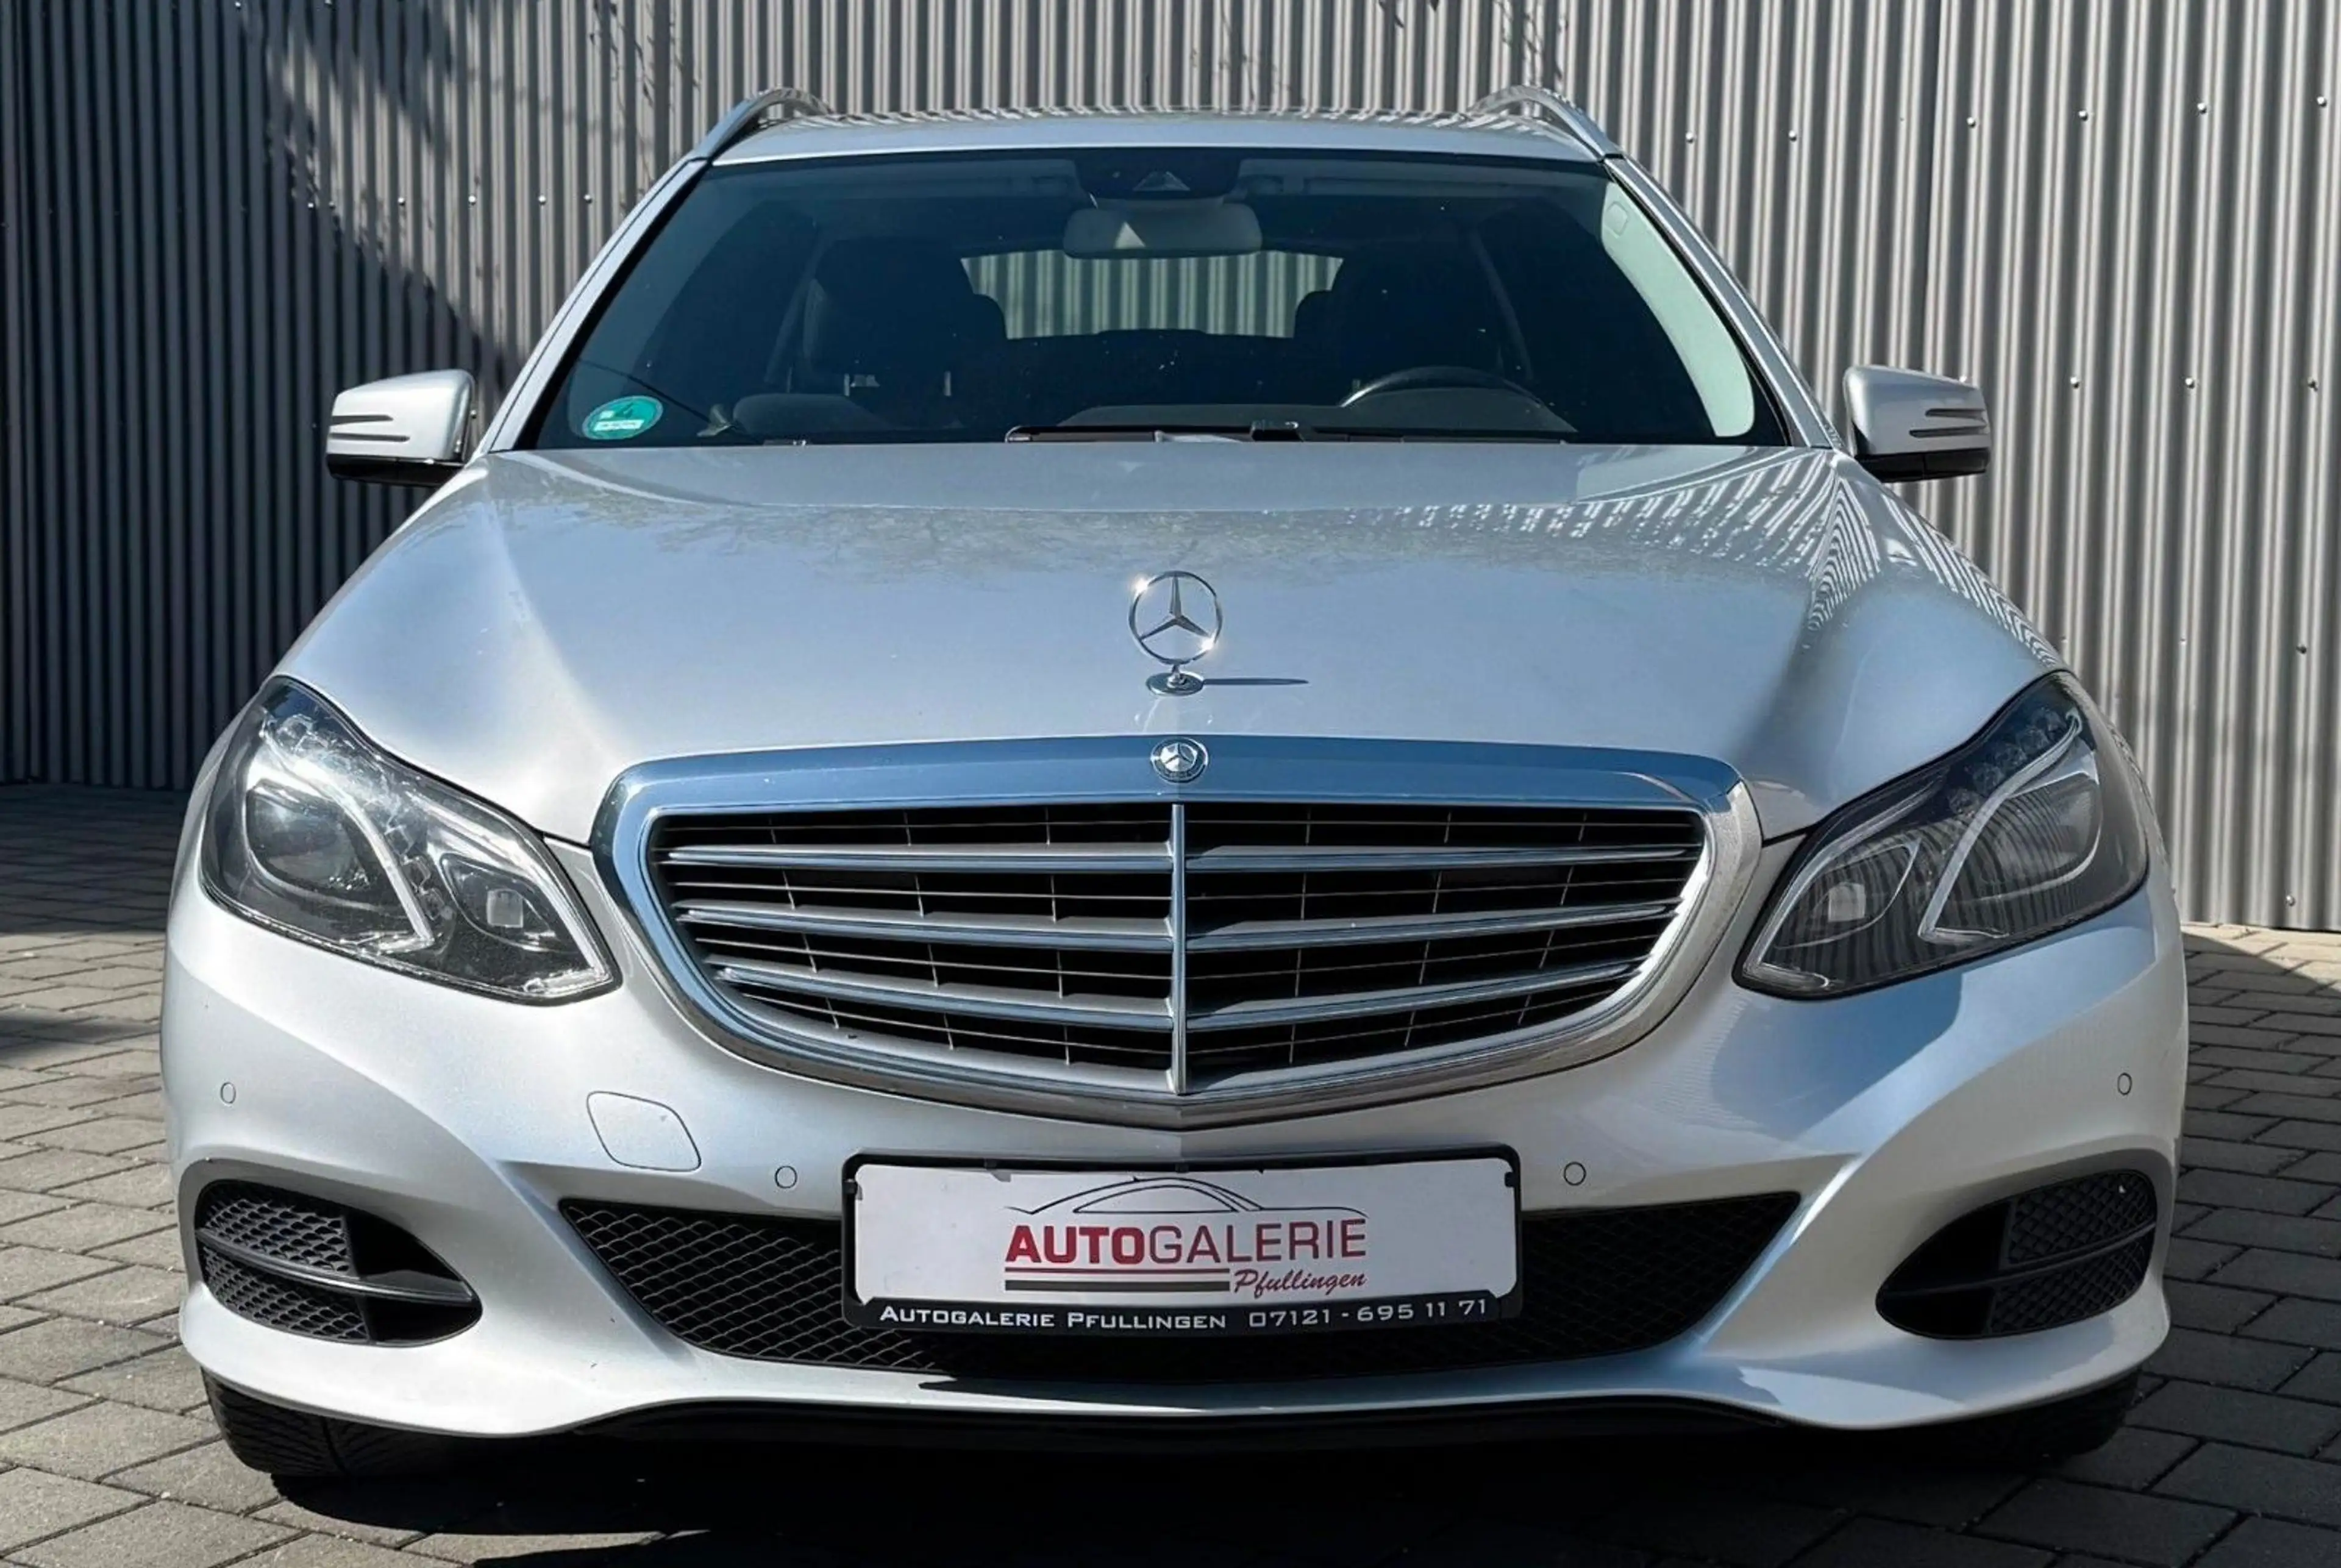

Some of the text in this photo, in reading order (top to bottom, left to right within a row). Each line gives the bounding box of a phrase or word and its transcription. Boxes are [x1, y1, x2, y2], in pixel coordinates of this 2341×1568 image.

[1004, 1218, 1367, 1265] AUTOGALERIE
[1233, 1268, 1367, 1299] Pfullingen
[879, 1305, 1055, 1327] AUTOGALERIE
[1067, 1311, 1226, 1329] PFULLINGEN
[1249, 1309, 1330, 1327] 07121
[1357, 1303, 1414, 1322] 695
[1426, 1302, 1445, 1317] 11
[1458, 1299, 1486, 1316] 71
